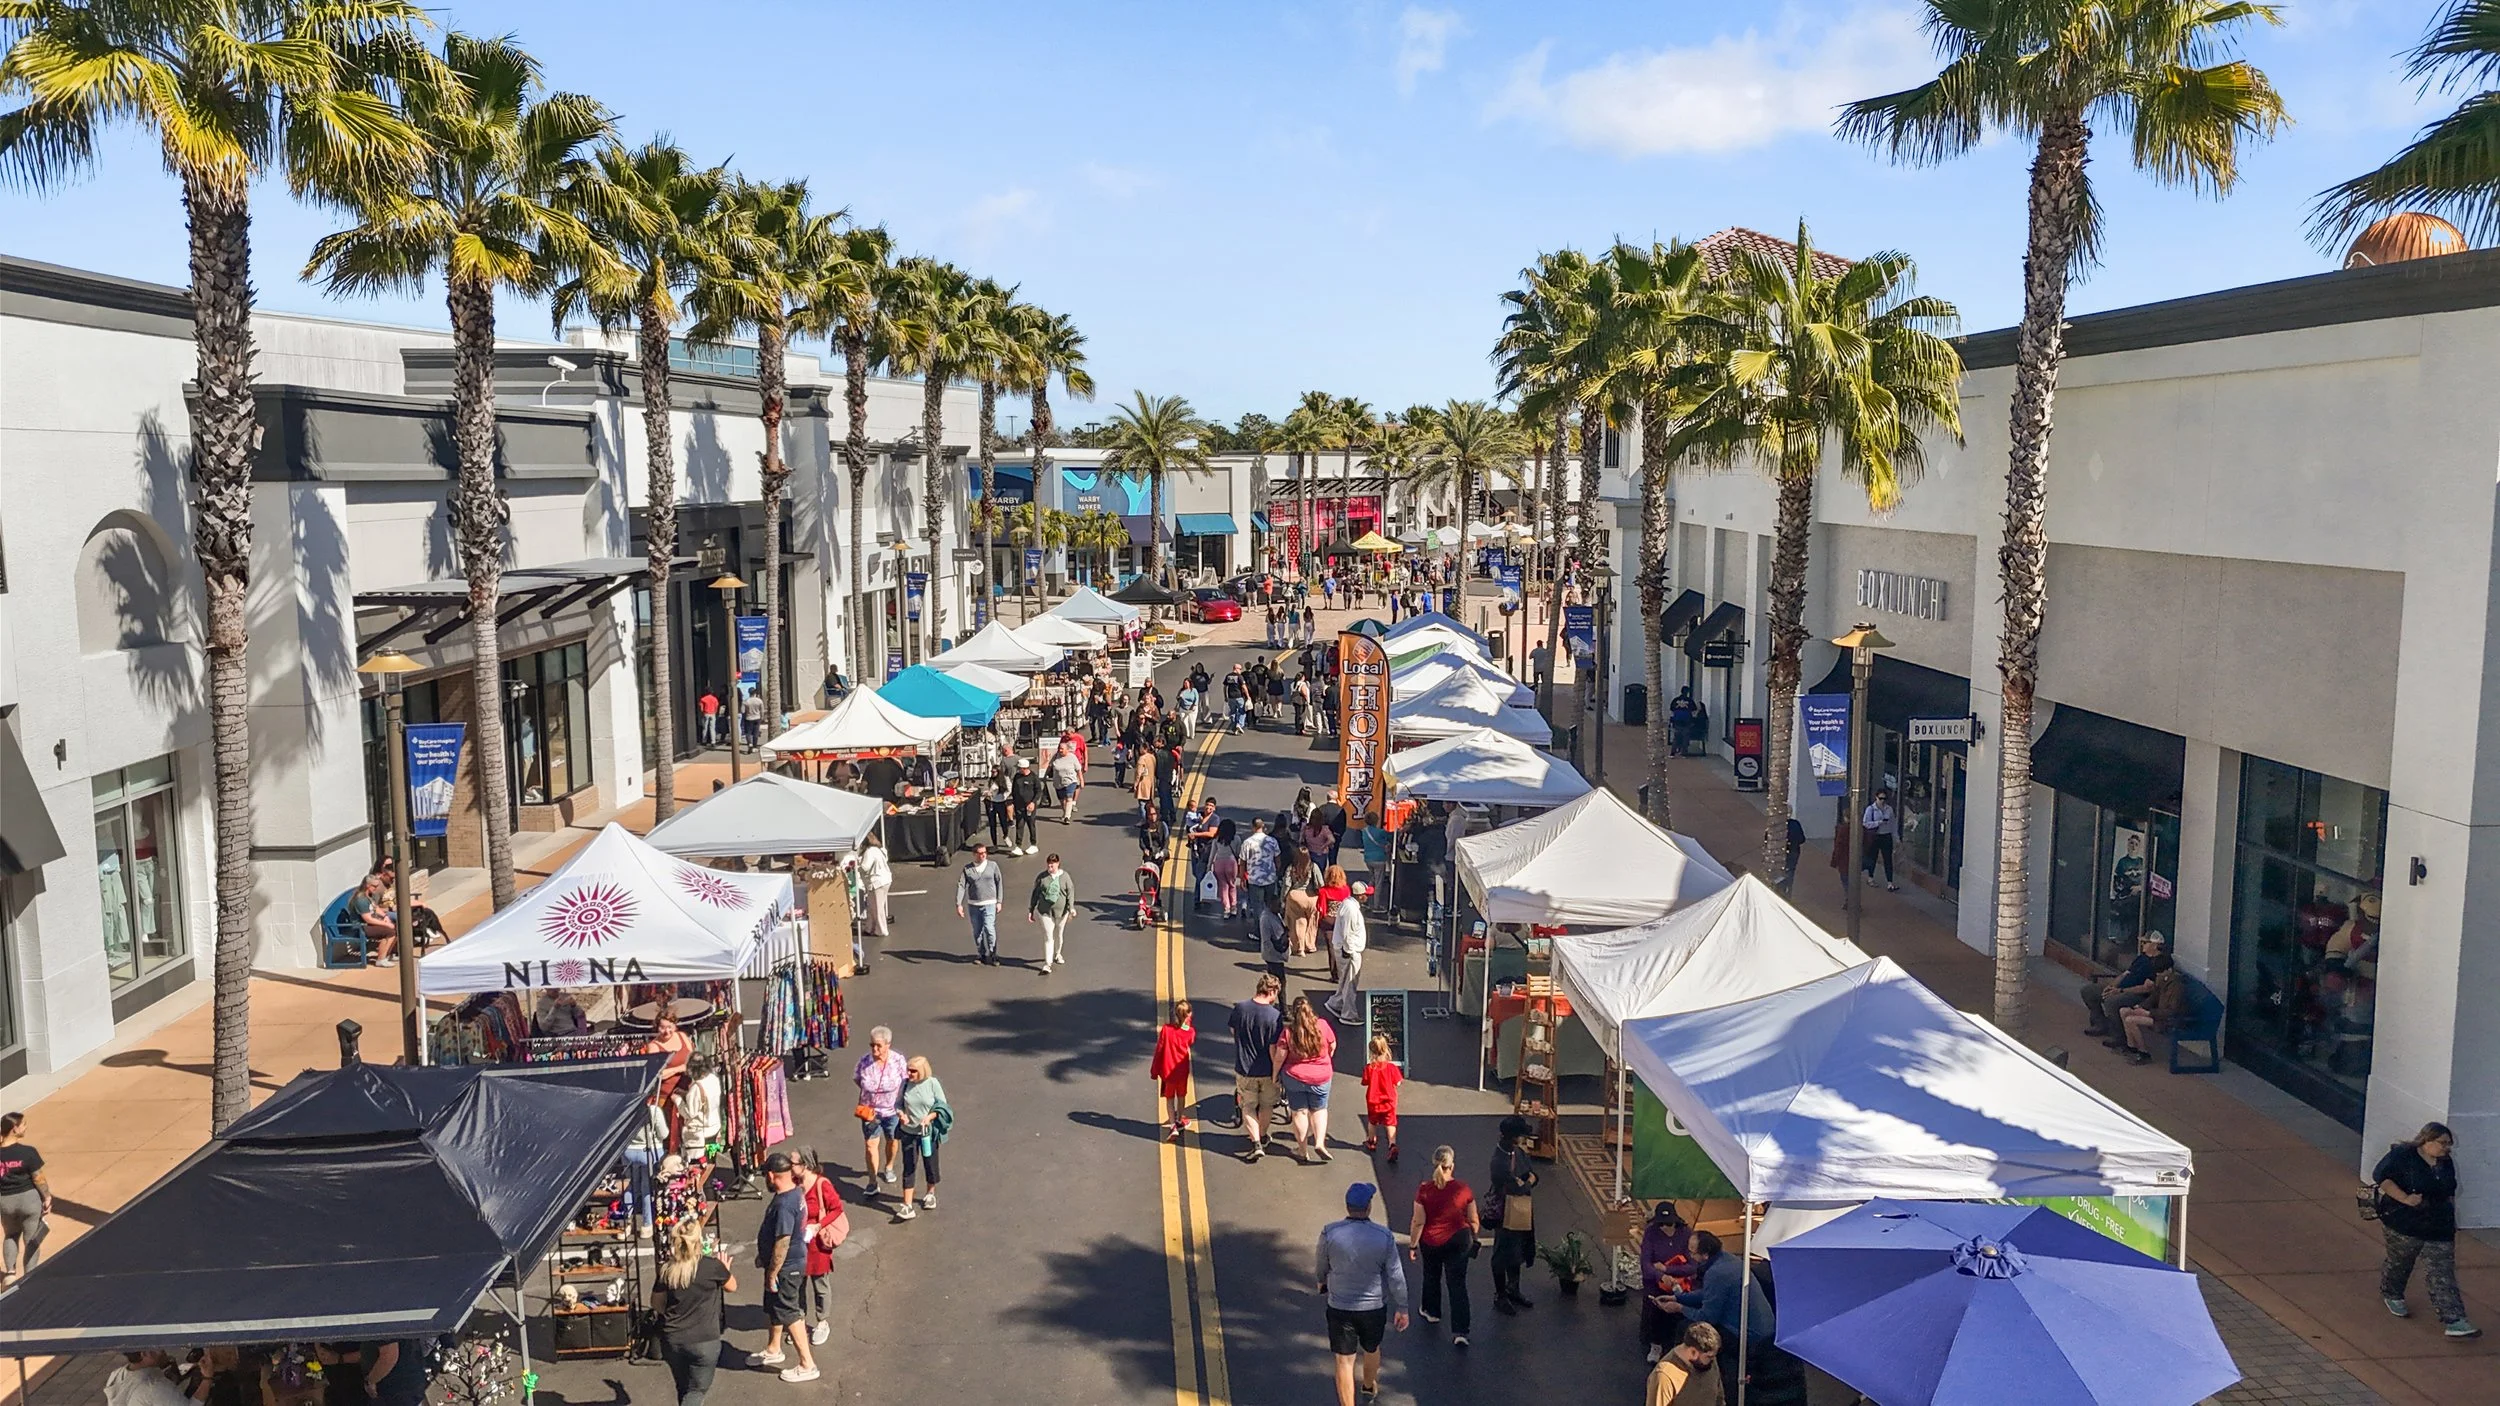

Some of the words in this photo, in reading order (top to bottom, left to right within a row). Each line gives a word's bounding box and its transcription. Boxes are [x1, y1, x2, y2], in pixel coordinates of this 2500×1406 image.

[1078, 495, 1101, 503] WARBY
[1077, 504, 1102, 512] PARKER
[1857, 570, 1940, 621] BOXLUNCH
[1342, 660, 1384, 675] Local
[1914, 725, 1965, 735] BOXLUNCH
[1346, 685, 1380, 820] HONEY
[2077, 1196, 2100, 1221] DRUG
[2105, 1216, 2126, 1240] FREE
